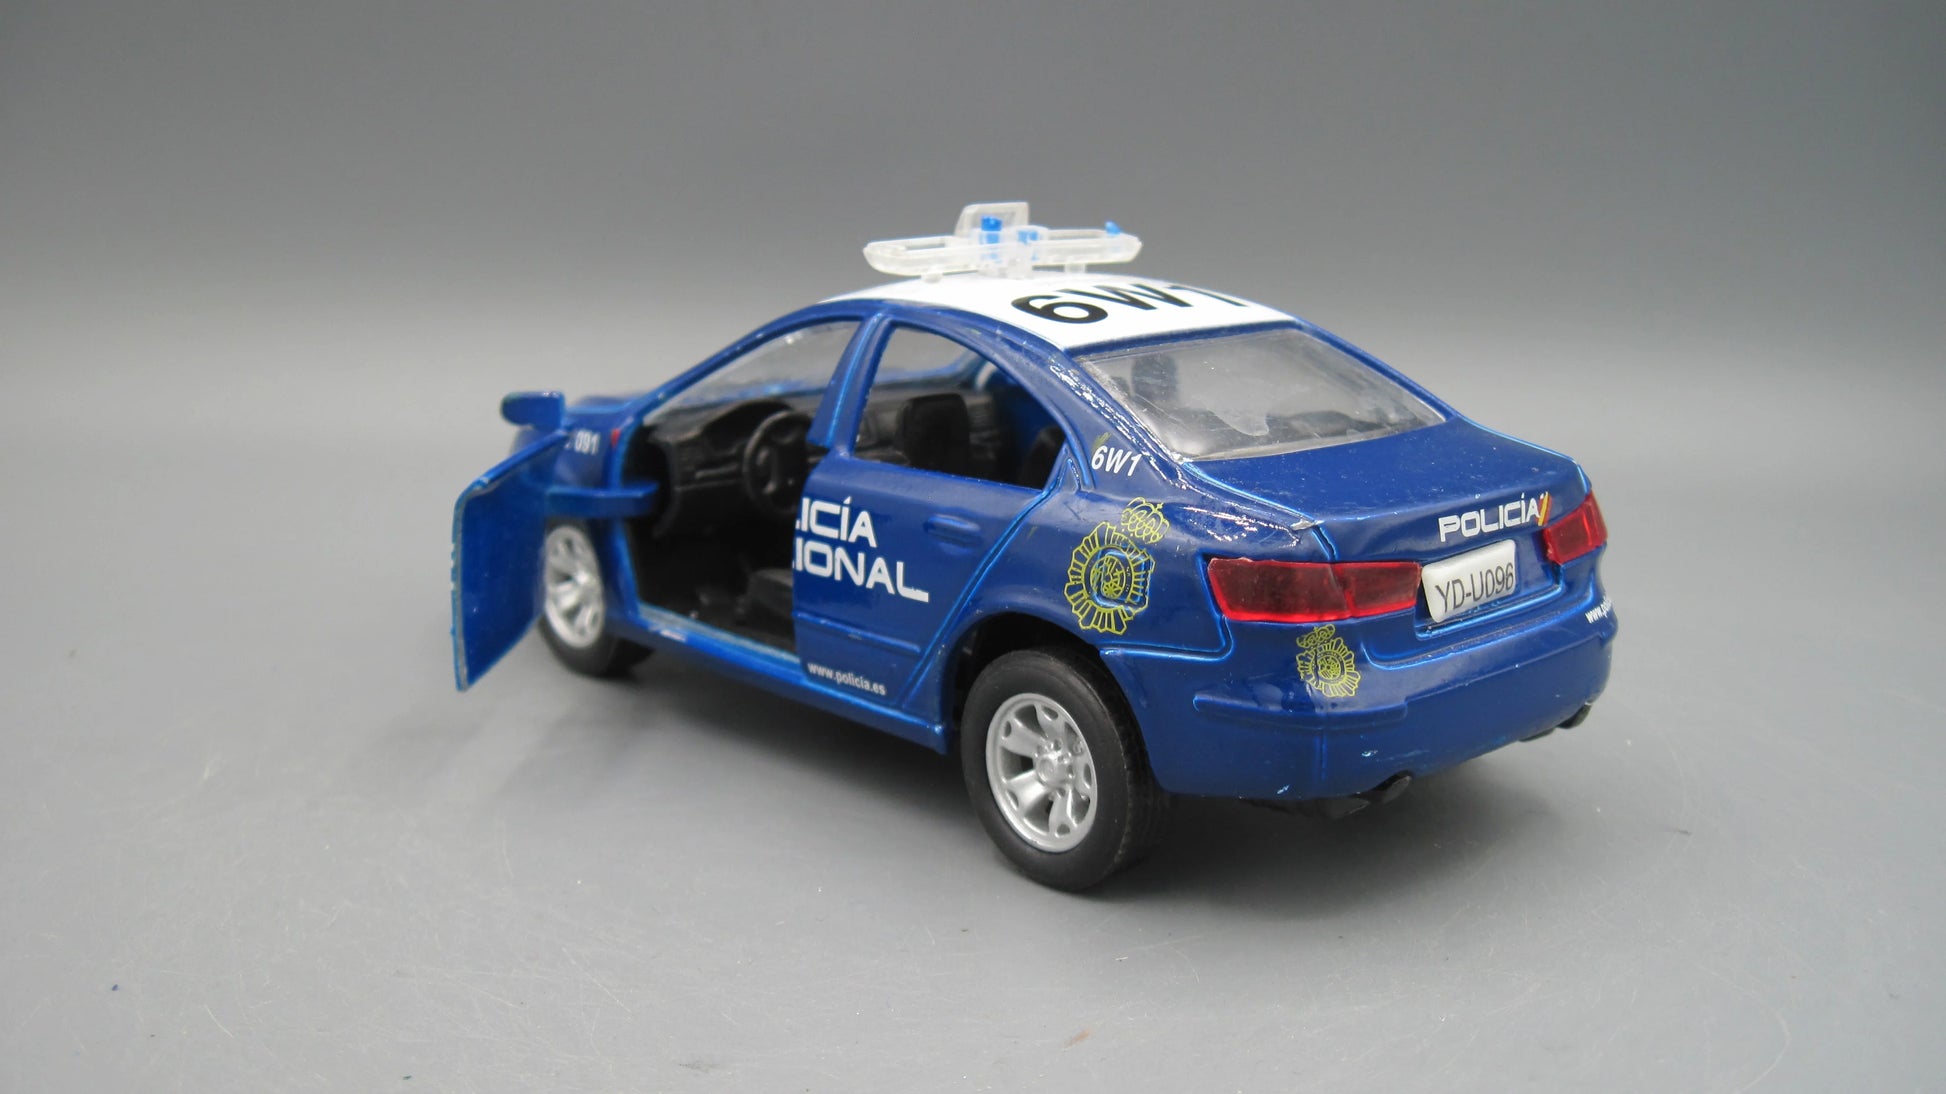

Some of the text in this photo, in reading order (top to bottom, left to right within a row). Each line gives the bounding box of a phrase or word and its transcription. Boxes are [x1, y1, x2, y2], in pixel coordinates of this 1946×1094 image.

[1011, 284, 1247, 324] 6W1
[1091, 446, 1142, 477] 6W1
[796, 496, 877, 548] ICÍA
[1438, 493, 1541, 542] POLICÍA
[792, 537, 929, 602] IONAL
[1435, 562, 1514, 613] YD-U096
[807, 662, 886, 696] www.policia.es
